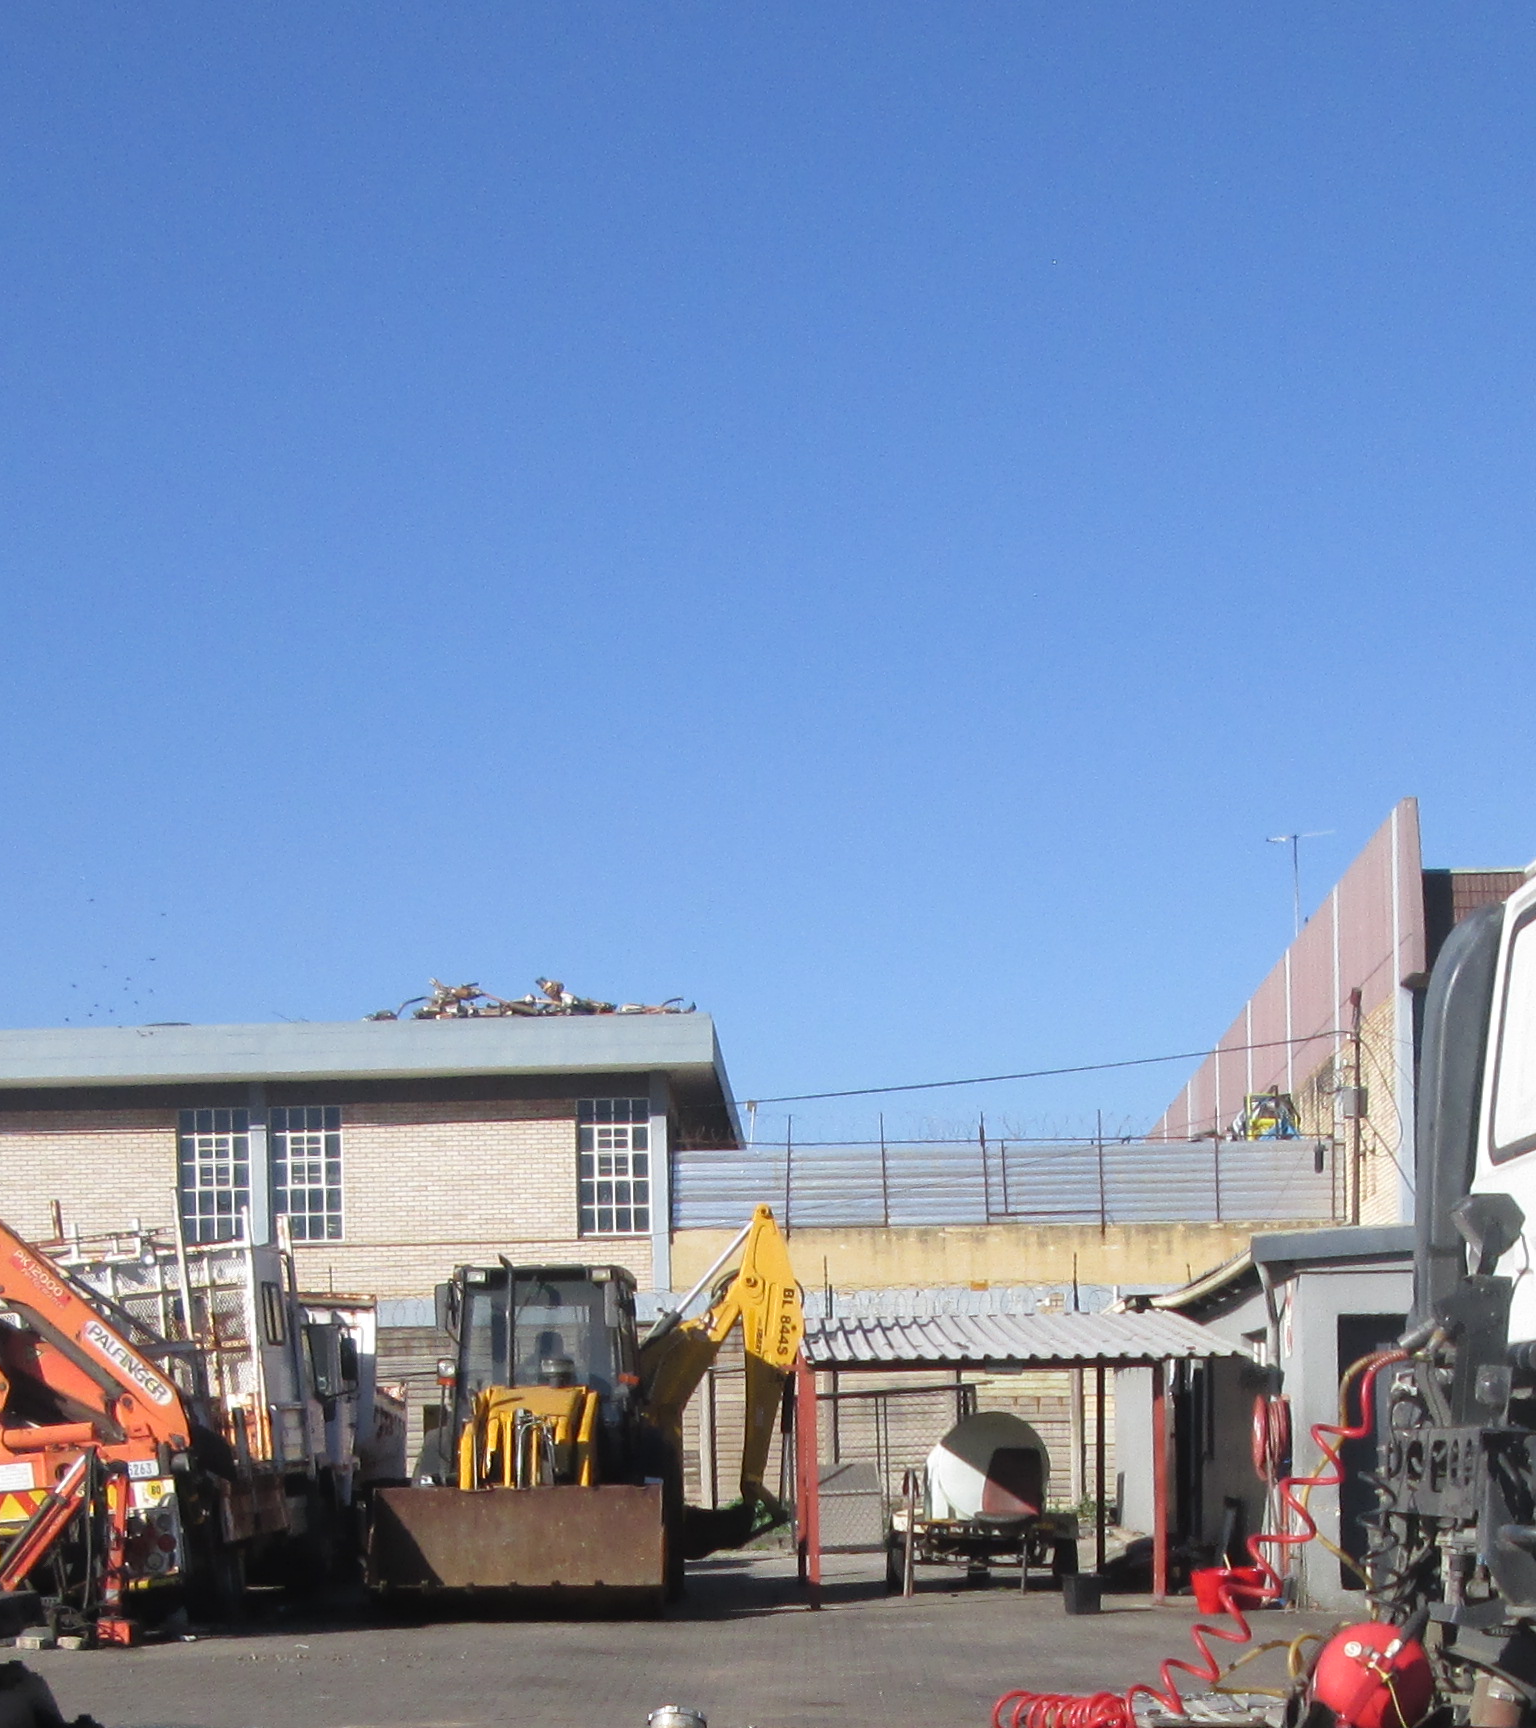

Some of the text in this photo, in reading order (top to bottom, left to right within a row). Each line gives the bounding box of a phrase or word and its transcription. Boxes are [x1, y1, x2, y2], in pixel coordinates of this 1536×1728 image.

[13, 1249, 32, 1267] PK
[782, 1288, 795, 1308] BL
[87, 1323, 169, 1401] PALFINGER
